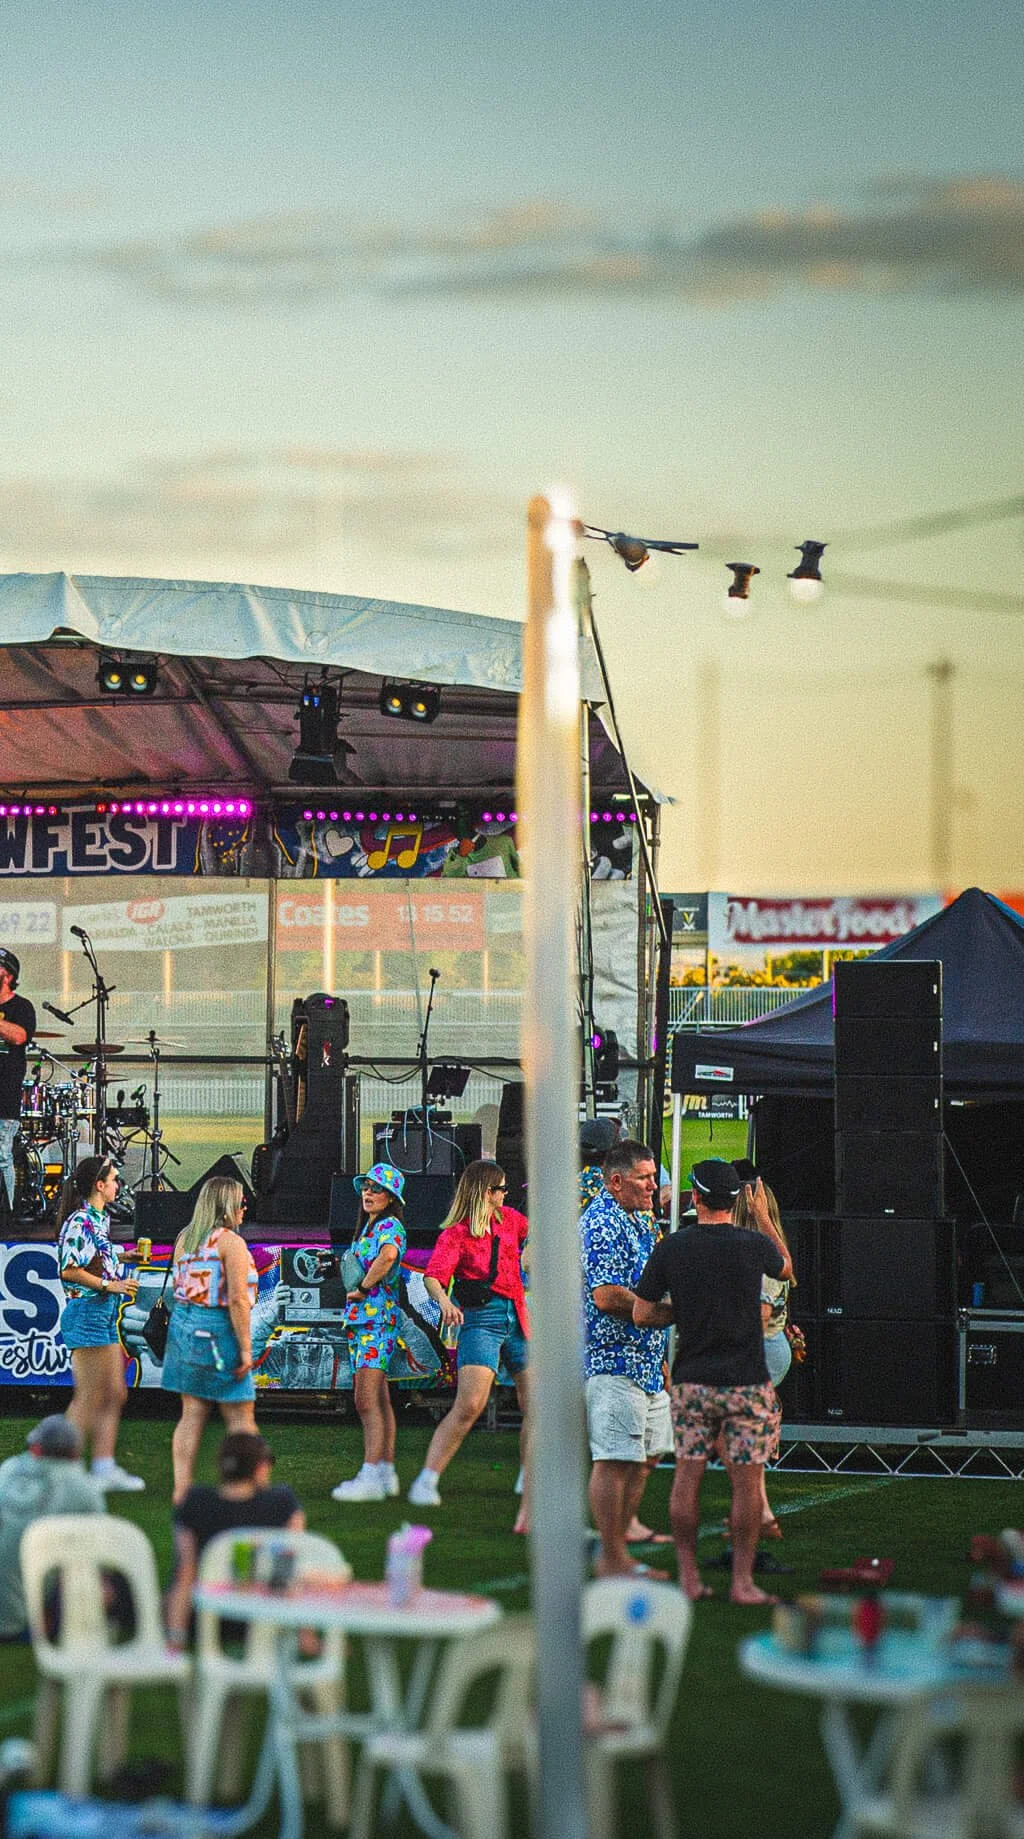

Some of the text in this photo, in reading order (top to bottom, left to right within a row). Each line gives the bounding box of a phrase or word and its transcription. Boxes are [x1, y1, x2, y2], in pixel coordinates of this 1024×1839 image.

[0, 911, 21, 932] 69
[26, 911, 51, 932] 22
[697, 1110, 734, 1119] TAMWORTH
